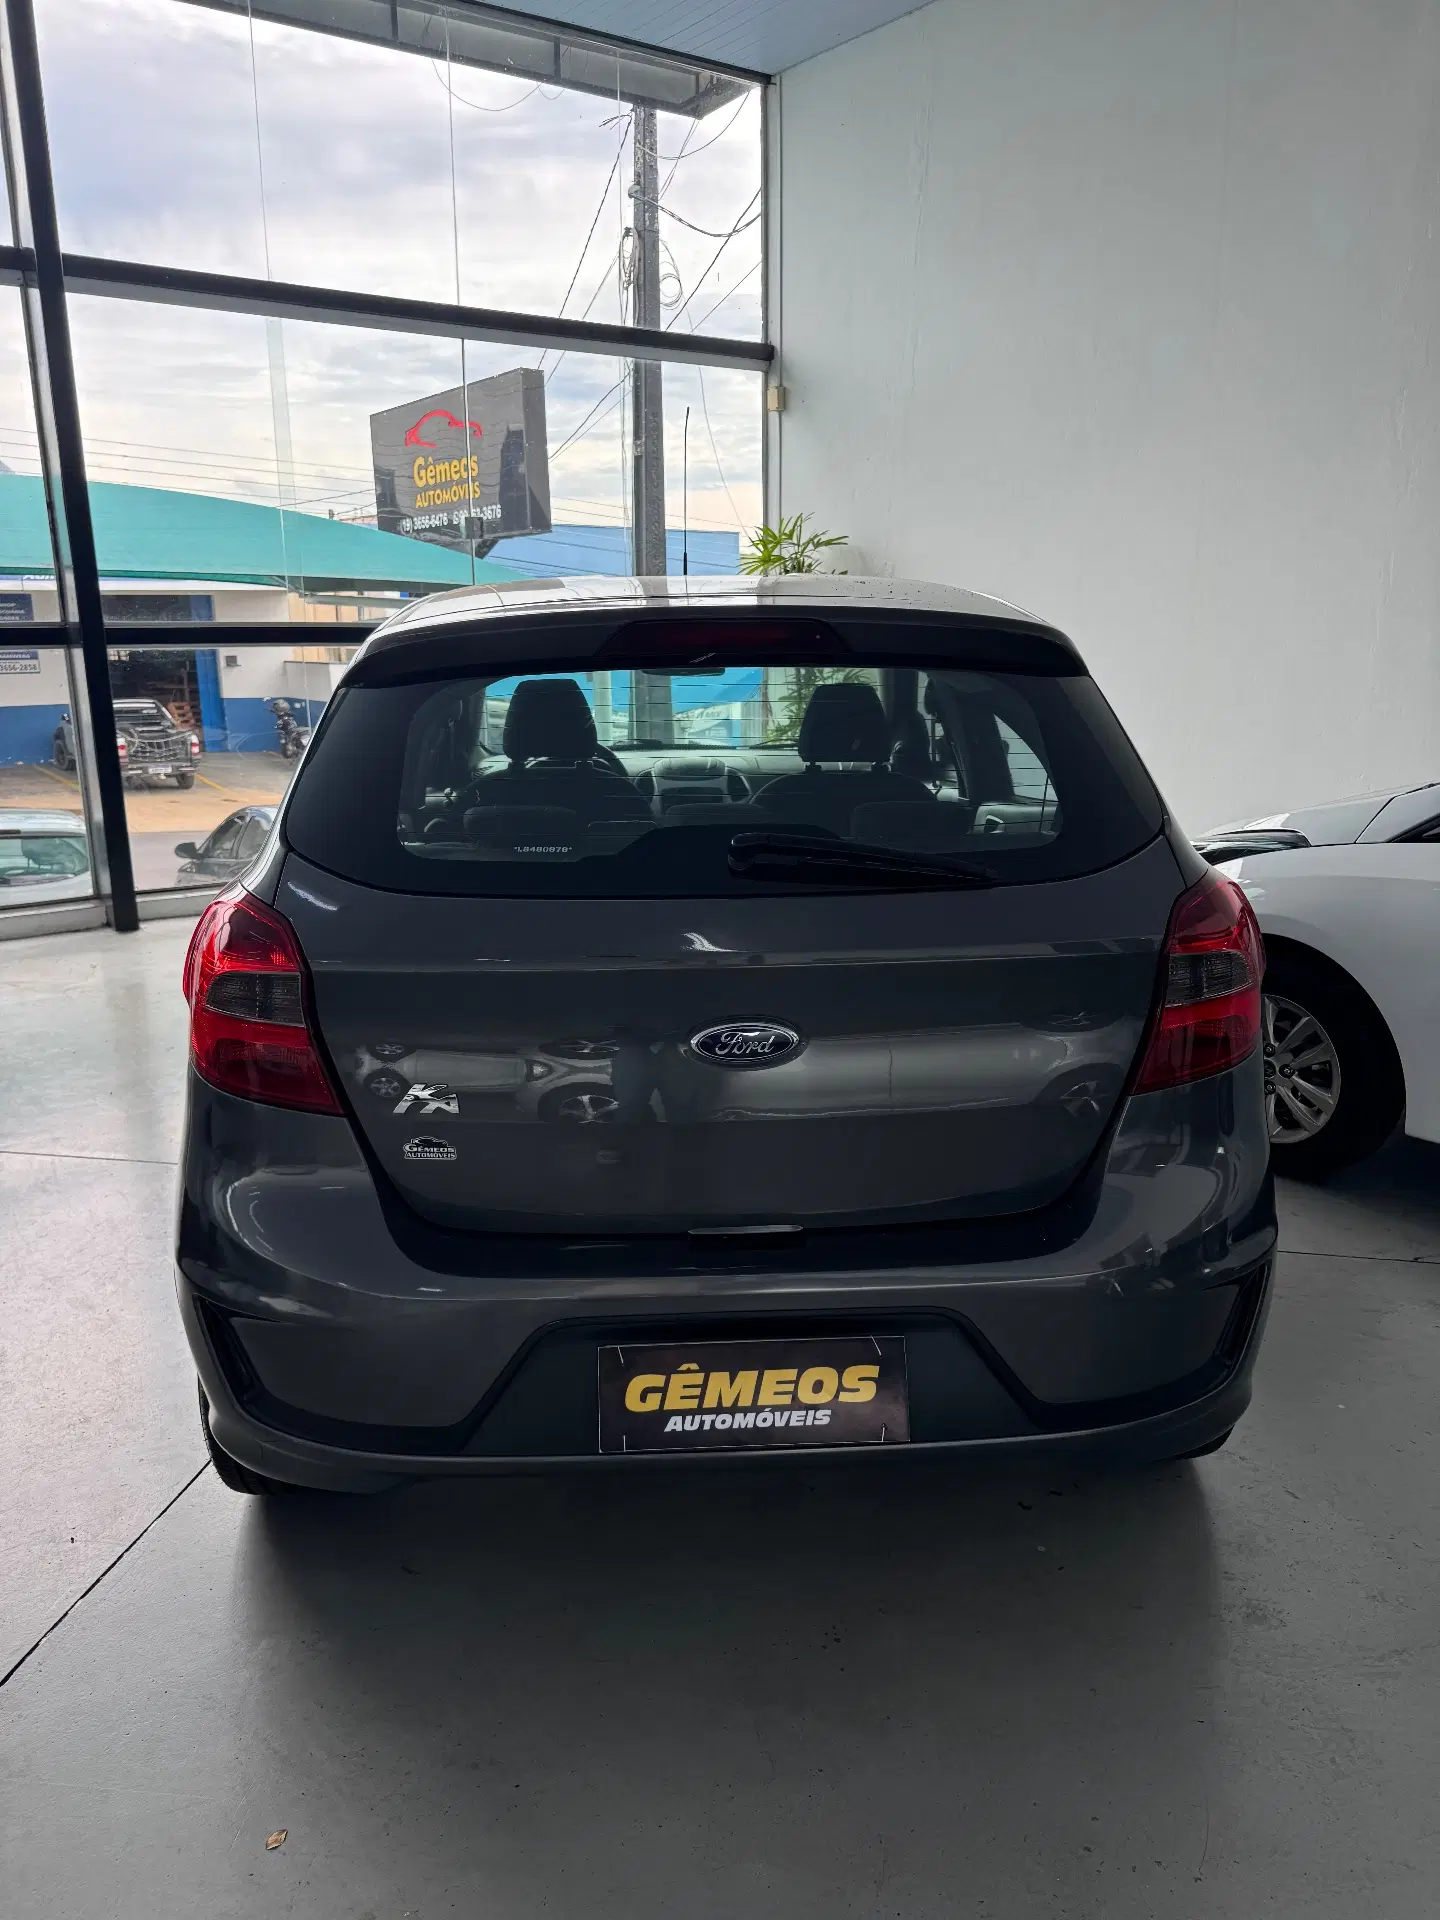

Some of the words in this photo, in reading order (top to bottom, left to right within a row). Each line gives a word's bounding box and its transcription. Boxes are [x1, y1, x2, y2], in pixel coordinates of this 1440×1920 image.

[715, 1031, 776, 1055] Ford
[624, 1362, 880, 1413] GÊMEOS
[664, 1408, 832, 1433] AUTOMÓVEIS
